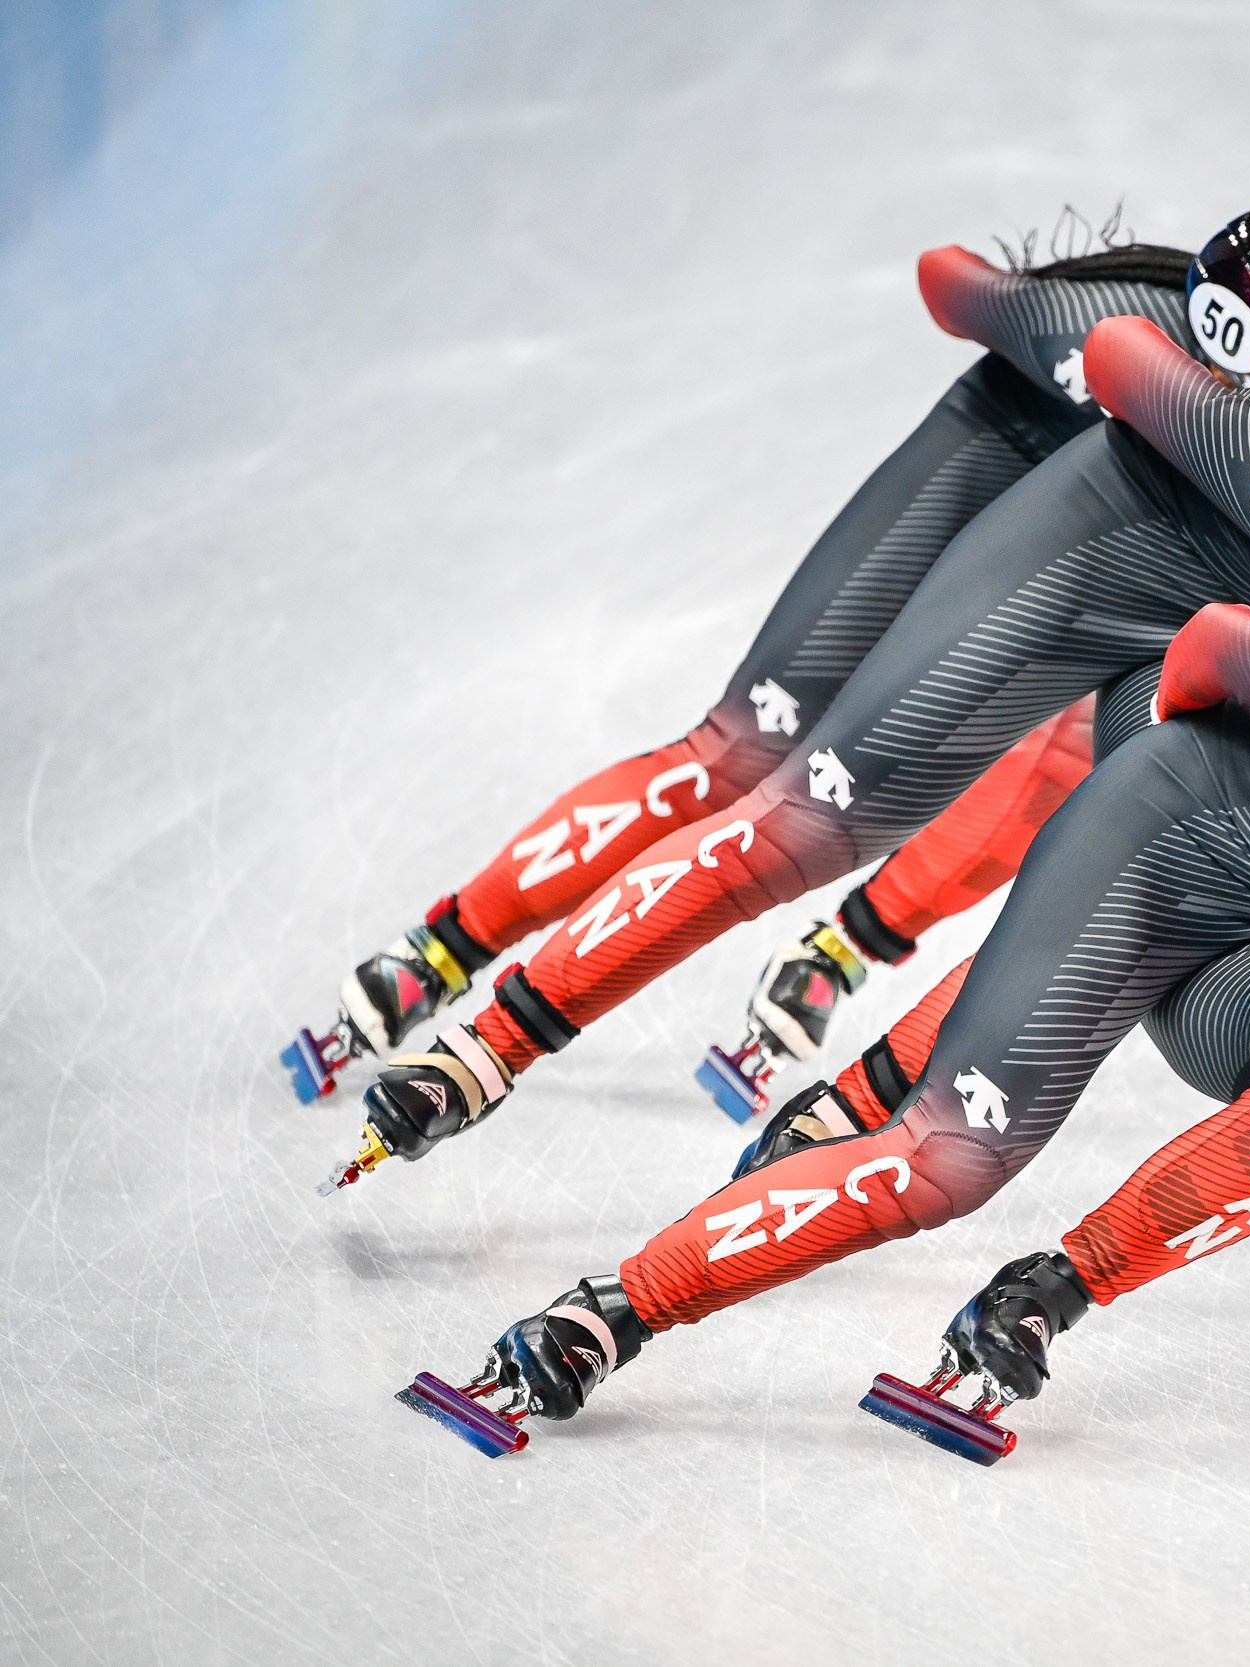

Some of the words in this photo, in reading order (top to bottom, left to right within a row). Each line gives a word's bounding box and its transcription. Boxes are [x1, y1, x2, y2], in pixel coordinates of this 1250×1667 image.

[1202, 299, 1244, 356] 50
[512, 761, 710, 891] CAN
[568, 819, 754, 959] CAN
[705, 1156, 911, 1262] CAN
